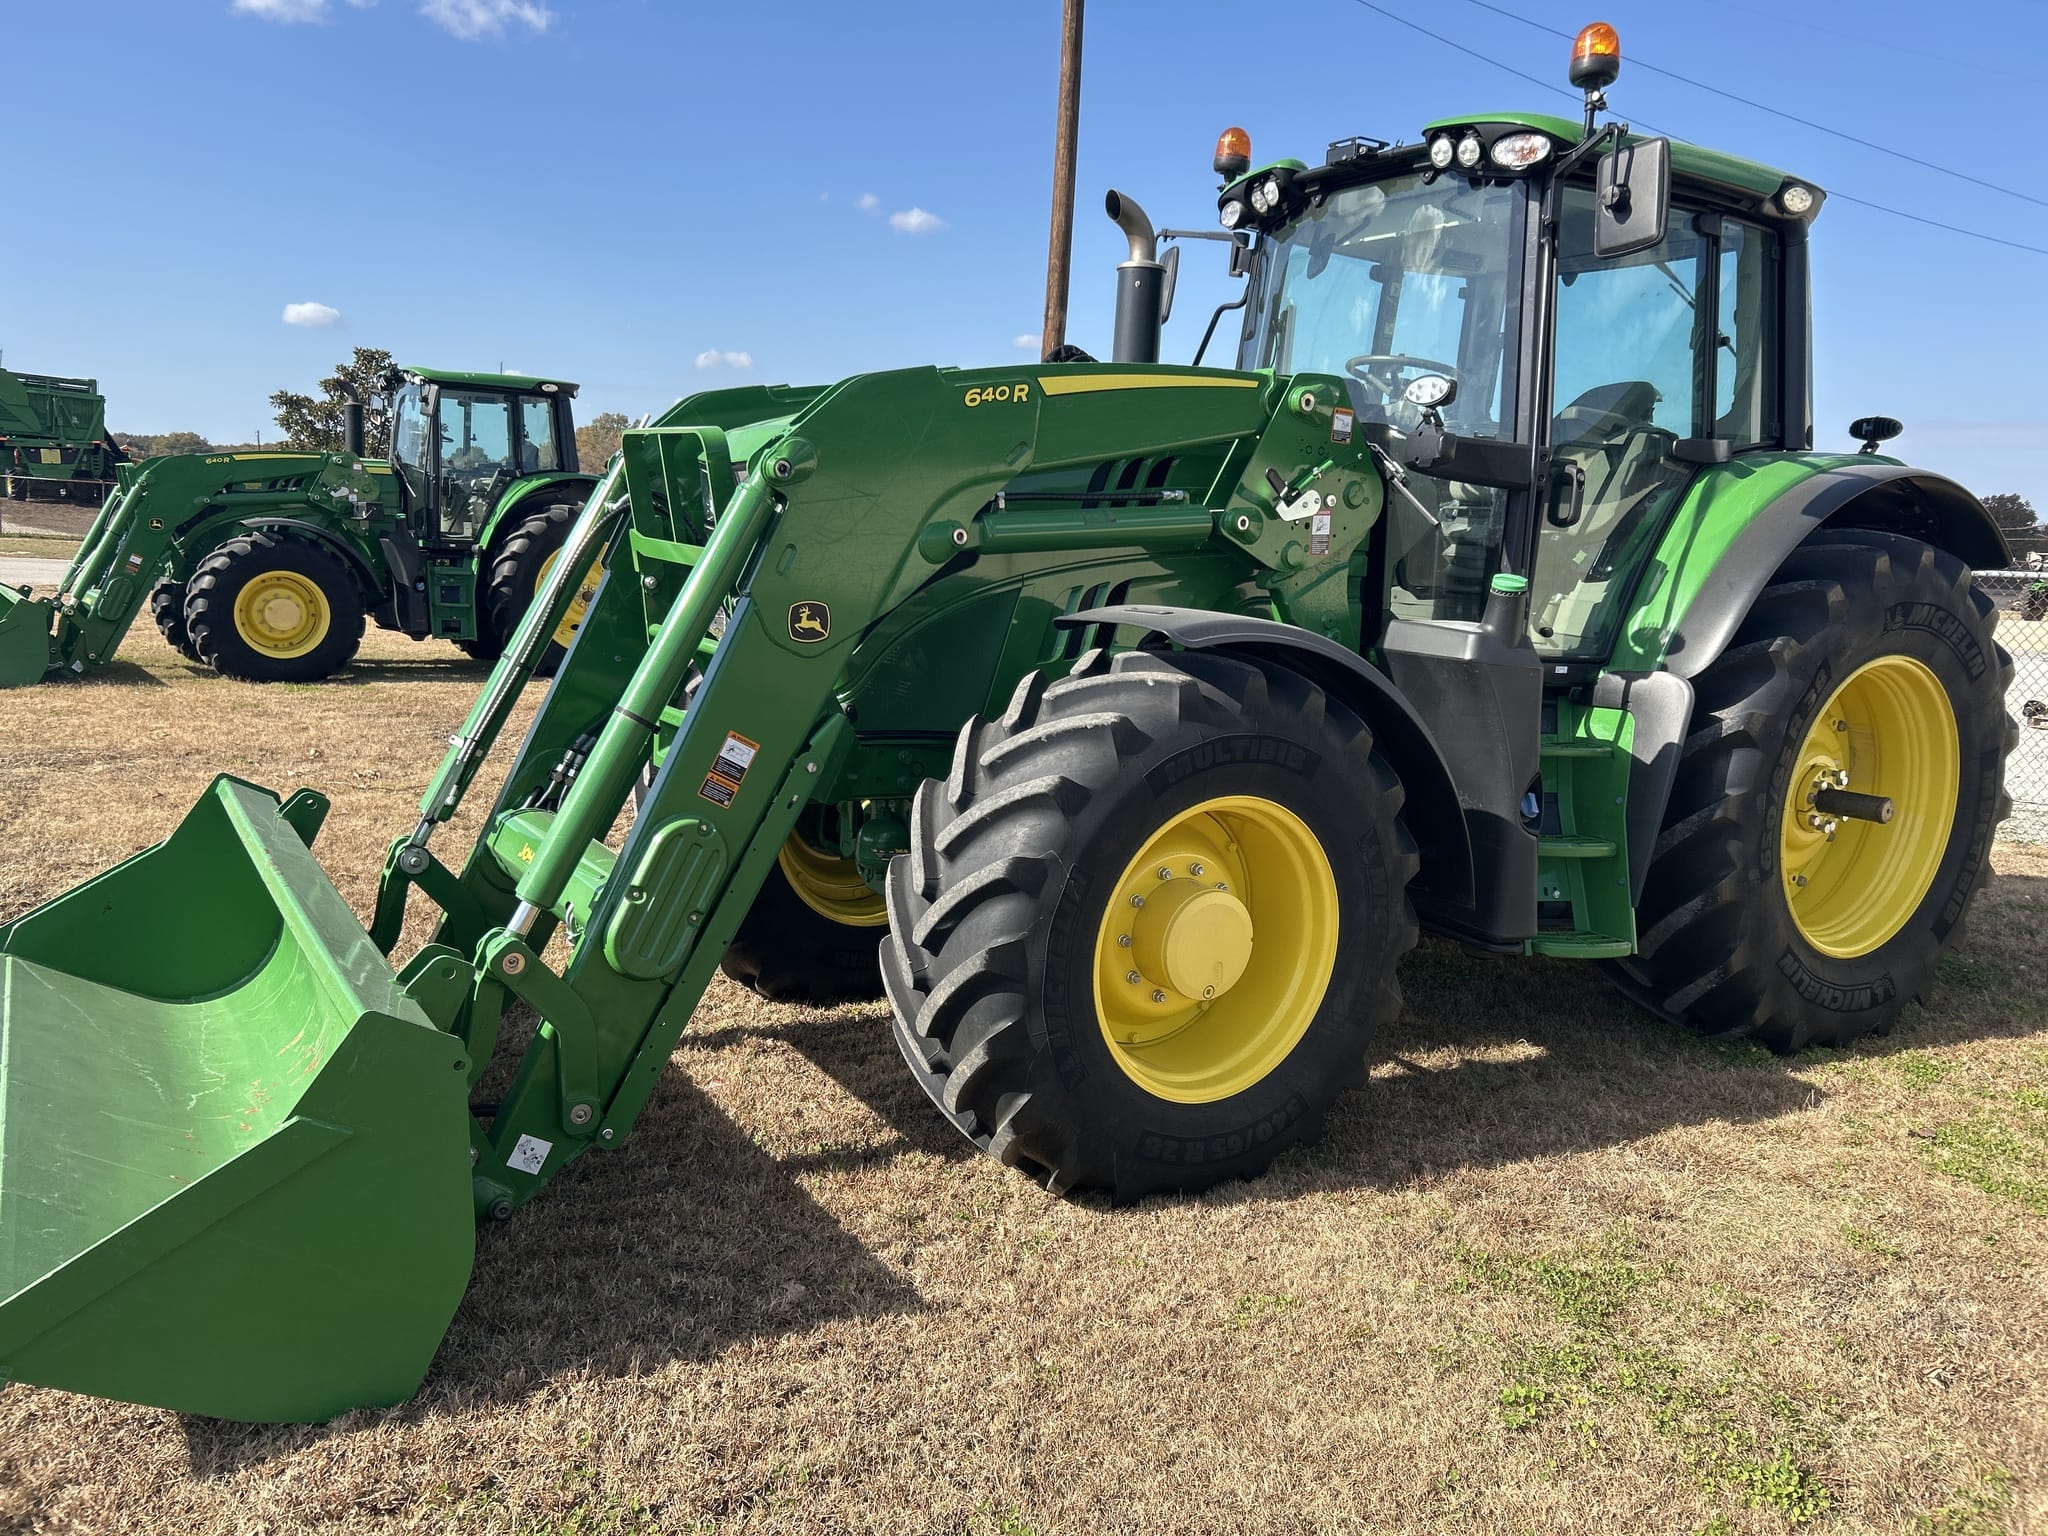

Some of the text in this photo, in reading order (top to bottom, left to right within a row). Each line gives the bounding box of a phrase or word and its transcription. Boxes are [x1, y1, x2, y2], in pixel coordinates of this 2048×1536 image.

[1905, 603, 1986, 678] MICHELIN
[1163, 738, 1307, 782] MULTIBIB
[1944, 769, 1996, 919] MULTIBIB
[1777, 953, 1872, 1010] MICHELIN
